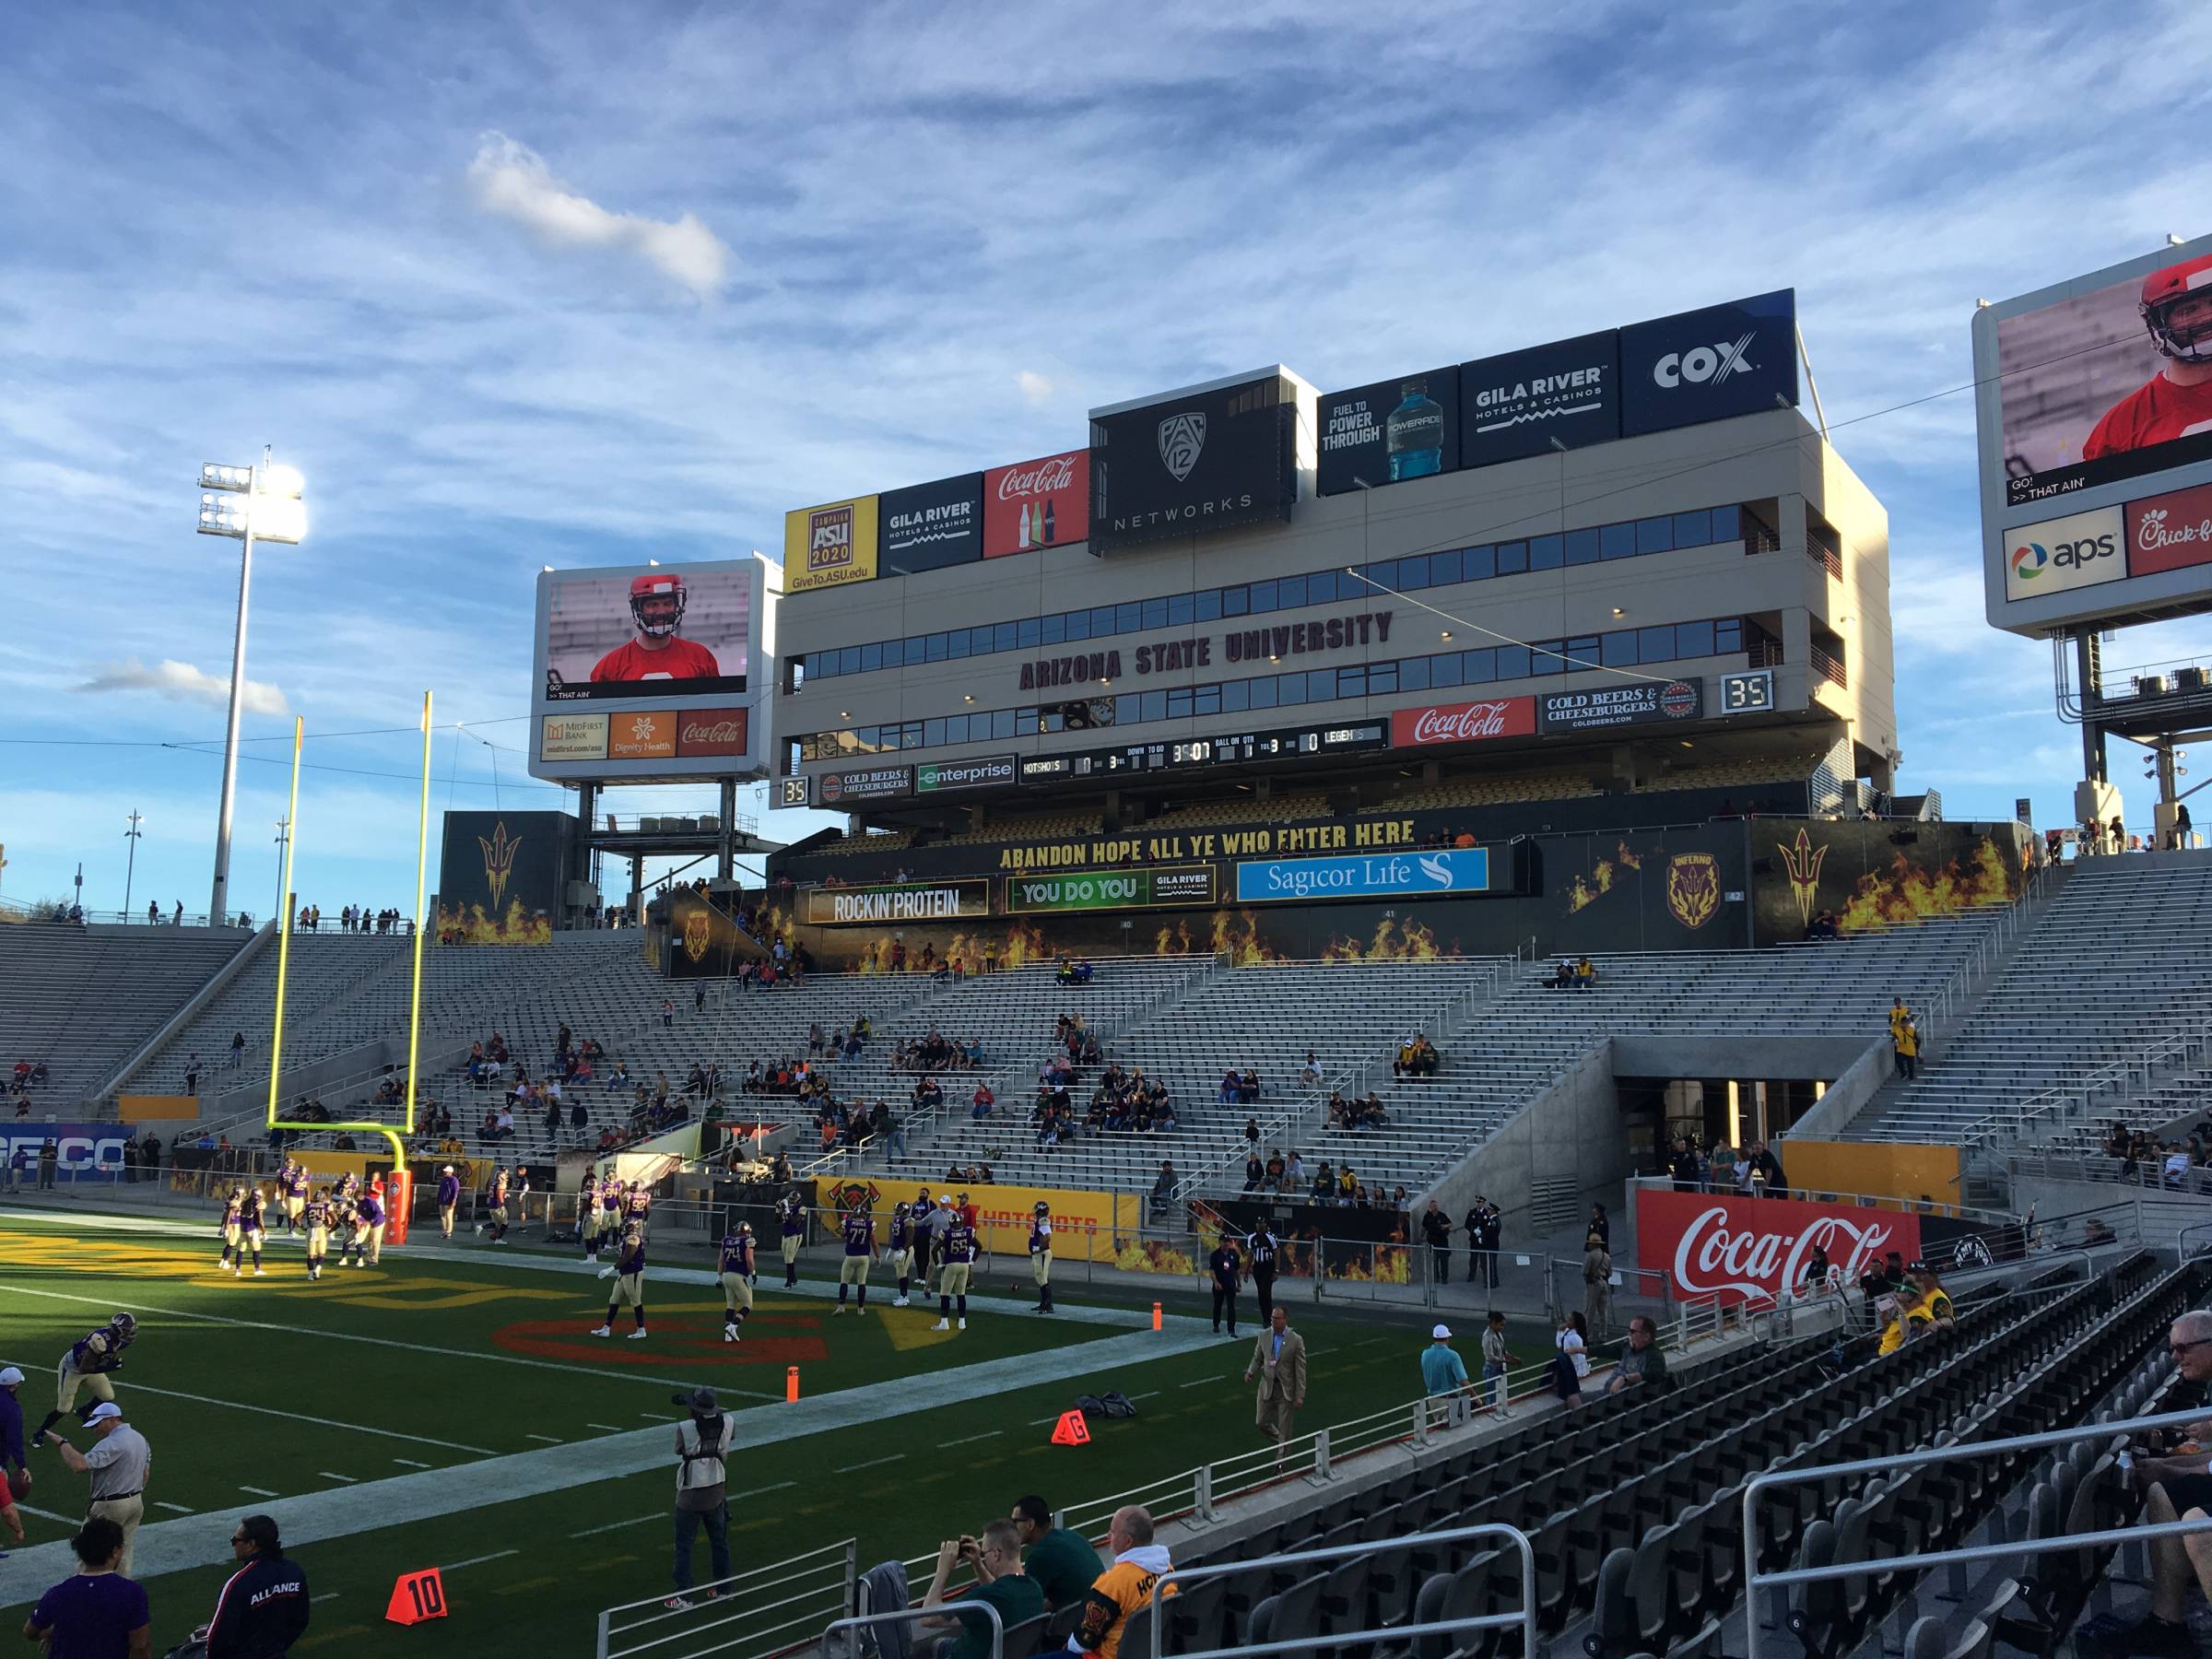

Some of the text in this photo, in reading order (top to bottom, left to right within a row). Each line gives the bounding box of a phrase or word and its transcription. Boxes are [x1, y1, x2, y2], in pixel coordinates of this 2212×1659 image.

[1653, 331, 1757, 388] COX
[1477, 367, 1601, 407] GILA RIVER
[1334, 400, 1367, 418] FUEL TO
[1476, 403, 1524, 419] HOTELS
[1544, 387, 1603, 406] CASINOS
[1329, 412, 1372, 434] POWER
[1323, 426, 1380, 451] THROUGH
[1173, 448, 1192, 469] 12
[998, 456, 1077, 500] Coca-Cola
[2012, 477, 2033, 489] GO!
[2029, 484, 2059, 499] THAT
[815, 512, 849, 526] CAMPAIGN
[889, 502, 971, 529] GILA RIVER
[1114, 494, 1253, 532] NETWORKS
[813, 523, 848, 548] ASU
[889, 527, 921, 539] HOTELS
[933, 518, 971, 531] CASINOS
[812, 545, 848, 564] 2020
[2053, 535, 2115, 569] aps
[793, 568, 867, 588] GiveTo.ASU.edu
[1019, 612, 1393, 690] ARIZONA STATE UNIVERSITY
[1547, 696, 1587, 710] COLD
[1592, 688, 1642, 705] BEERS
[1647, 688, 1657, 700] &
[1732, 677, 1764, 707] 35
[1547, 700, 1656, 721] CHEESEBURGERS
[1414, 701, 1511, 743] Coca-Cola
[1572, 716, 1632, 727] COLDBEERS.COM
[615, 742, 670, 754] Dignity Health
[1127, 747, 1144, 756] DOWN
[1216, 738, 1230, 747] BALL
[1271, 739, 1278, 752] 3
[1309, 734, 1318, 751] 0
[921, 763, 1012, 783] enterprise
[1023, 760, 1060, 774] HOTSHOTS
[1110, 756, 1116, 769] 3
[844, 770, 909, 784] COLD BEERS &
[844, 779, 909, 794] CHEESEBURGERS
[786, 781, 805, 802] 35
[1000, 819, 1415, 868] ABANDON HOPE ALL YE WHO ENTER HERE
[1675, 855, 1712, 866] INFERNO
[1157, 875, 1206, 885] GILA RIVER
[1268, 856, 1410, 896] Sagicor Life
[1022, 878, 1136, 903] YOU DO YOU
[1729, 892, 1741, 900] 42
[834, 889, 959, 921] ROCKIN' PROTEIN
[0, 1137, 127, 1171] ECO
[982, 1210, 1098, 1236] HOTSOTS
[850, 1228, 867, 1245] 77
[725, 1246, 742, 1262] 74
[1675, 1206, 1892, 1303] Coca-Col
[1069, 1416, 1086, 1439] G
[251, 1583, 300, 1606] ALLANCE
[407, 1575, 442, 1618] 10
[2023, 1585, 2030, 1594] 7
[1793, 1619, 1800, 1629] 6
[1590, 1641, 1595, 1651] 5
